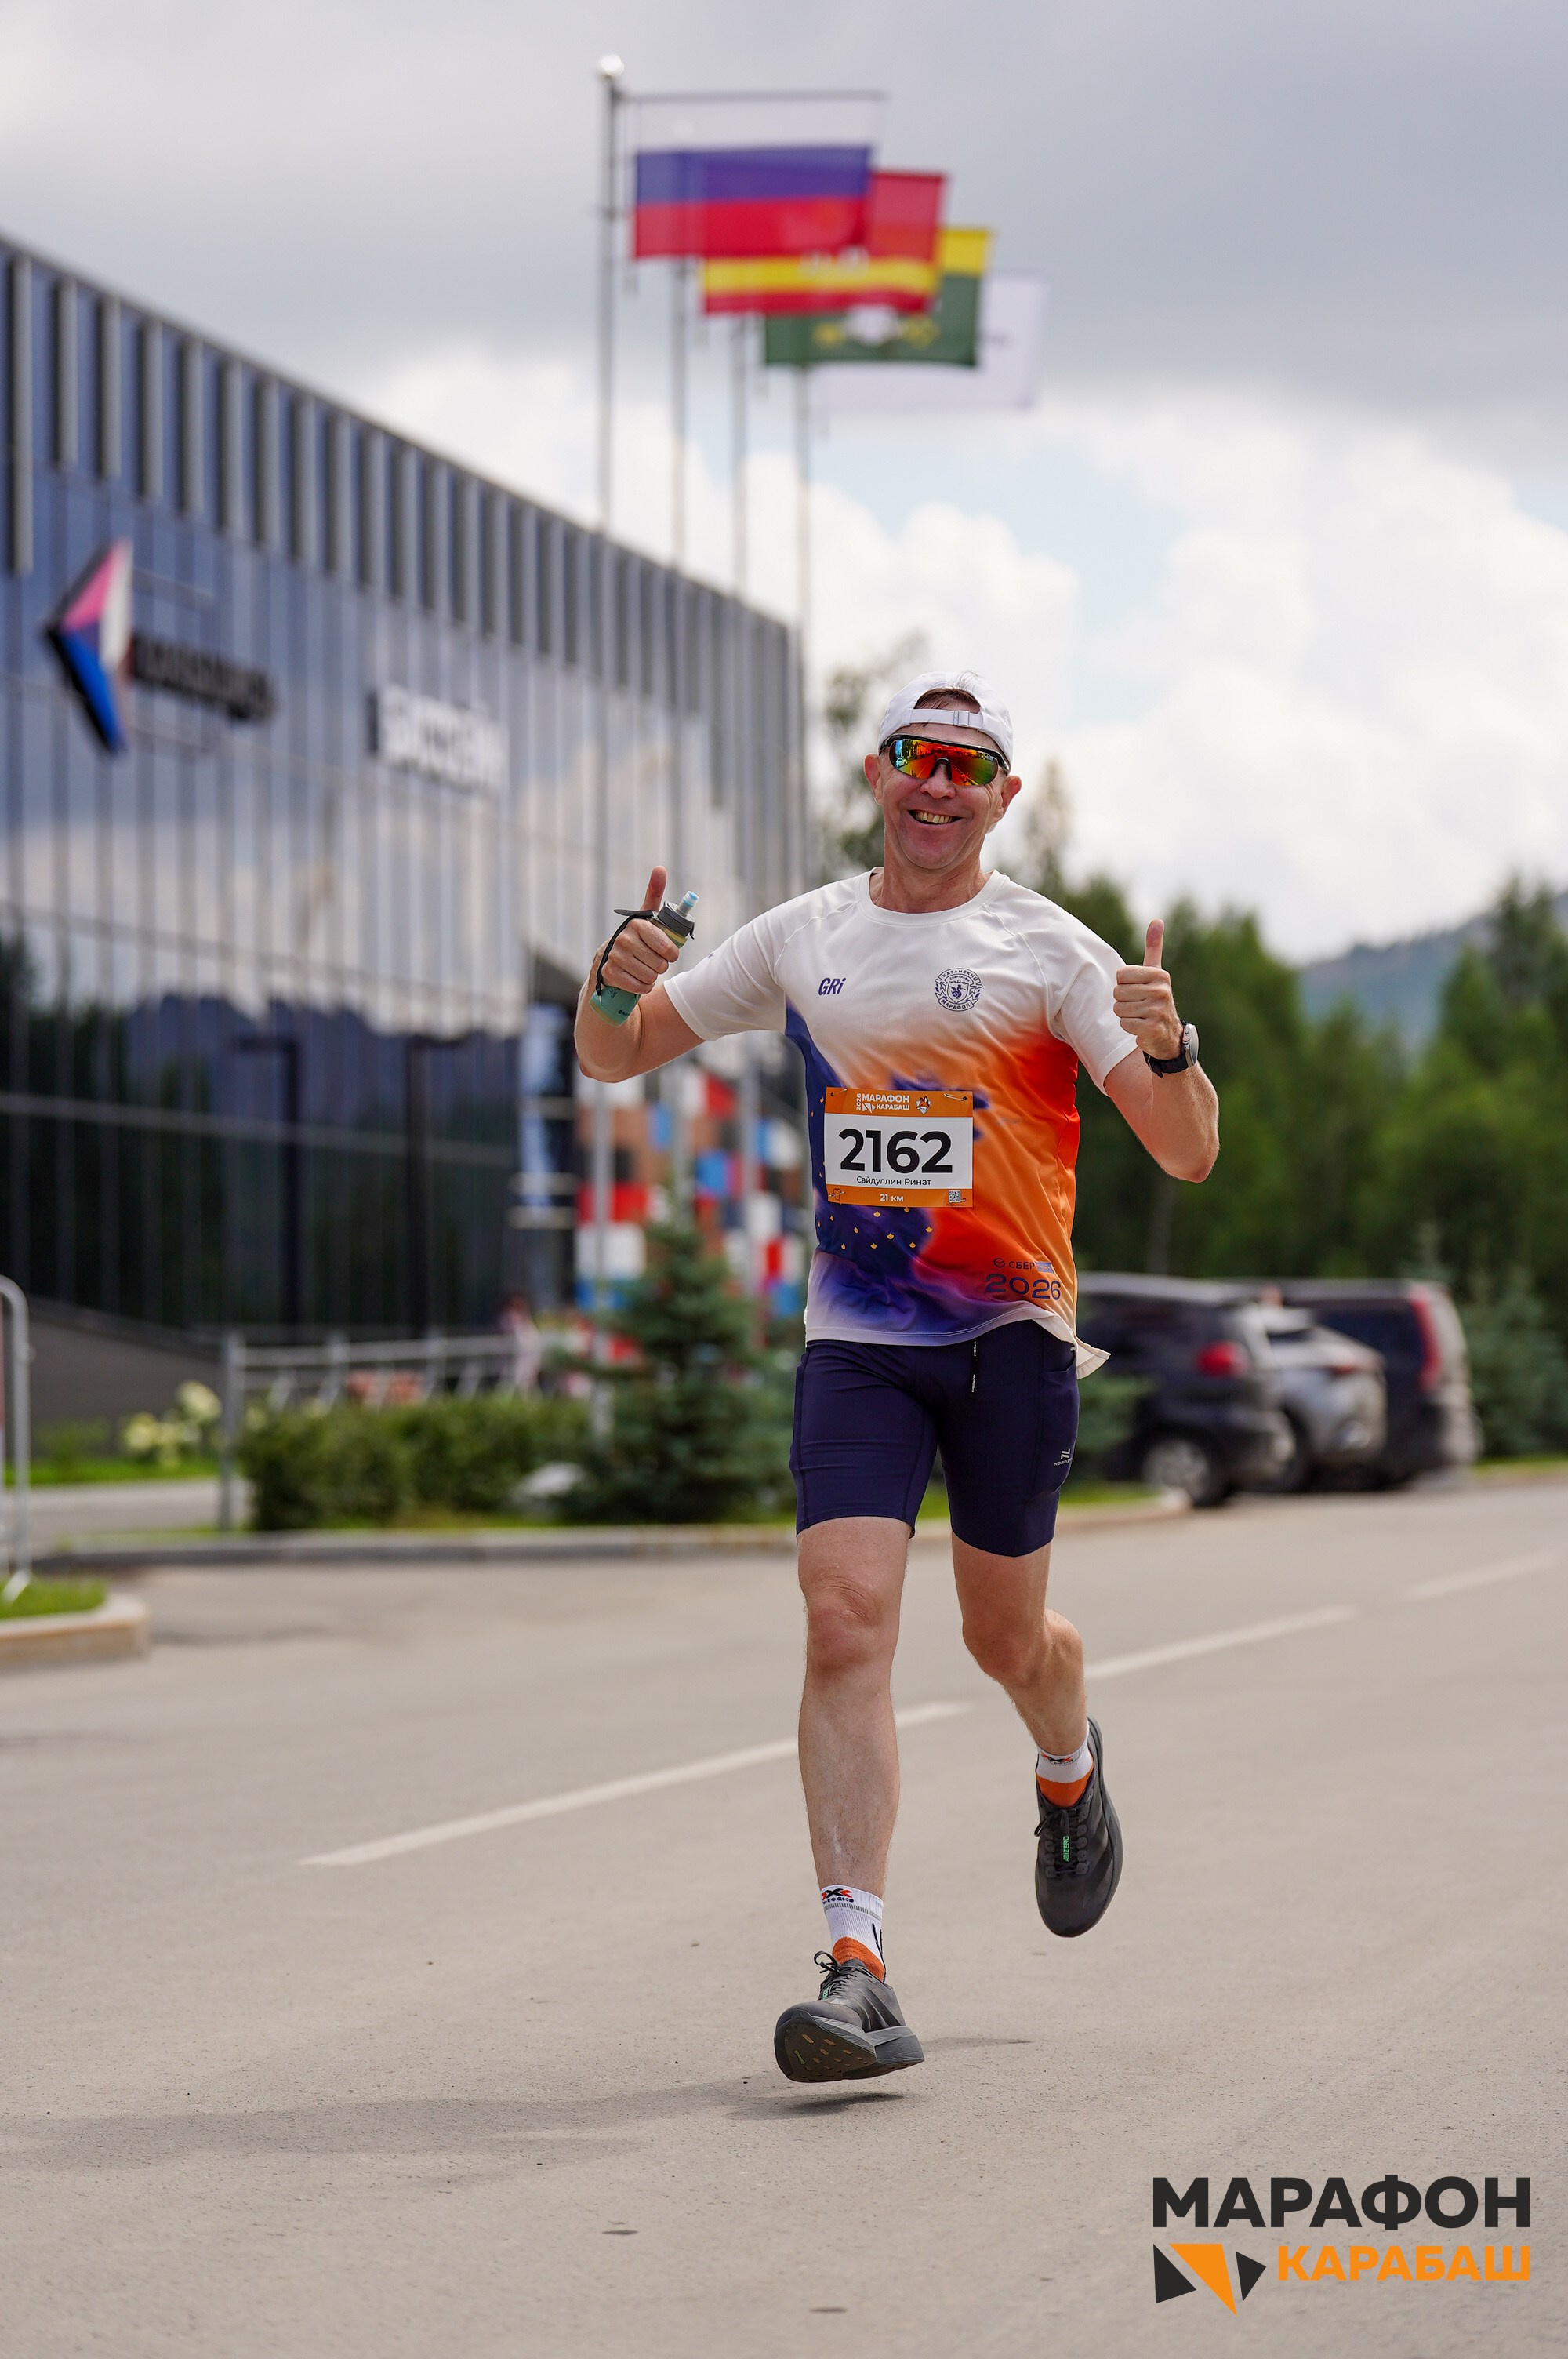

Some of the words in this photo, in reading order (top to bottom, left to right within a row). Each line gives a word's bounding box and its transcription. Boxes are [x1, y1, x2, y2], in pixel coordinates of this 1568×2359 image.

[942, 970, 978, 981] КАЗАНСКИЙ
[818, 977, 846, 995] GRi
[941, 999, 970, 1009] МАРАФОН
[862, 1093, 909, 1103] МАРАФОН
[838, 1128, 953, 1173] 2162
[856, 1176, 902, 1186] Сайдуллин
[1008, 1260, 1035, 1270] СБЕР
[985, 1273, 1061, 1300] 2026
